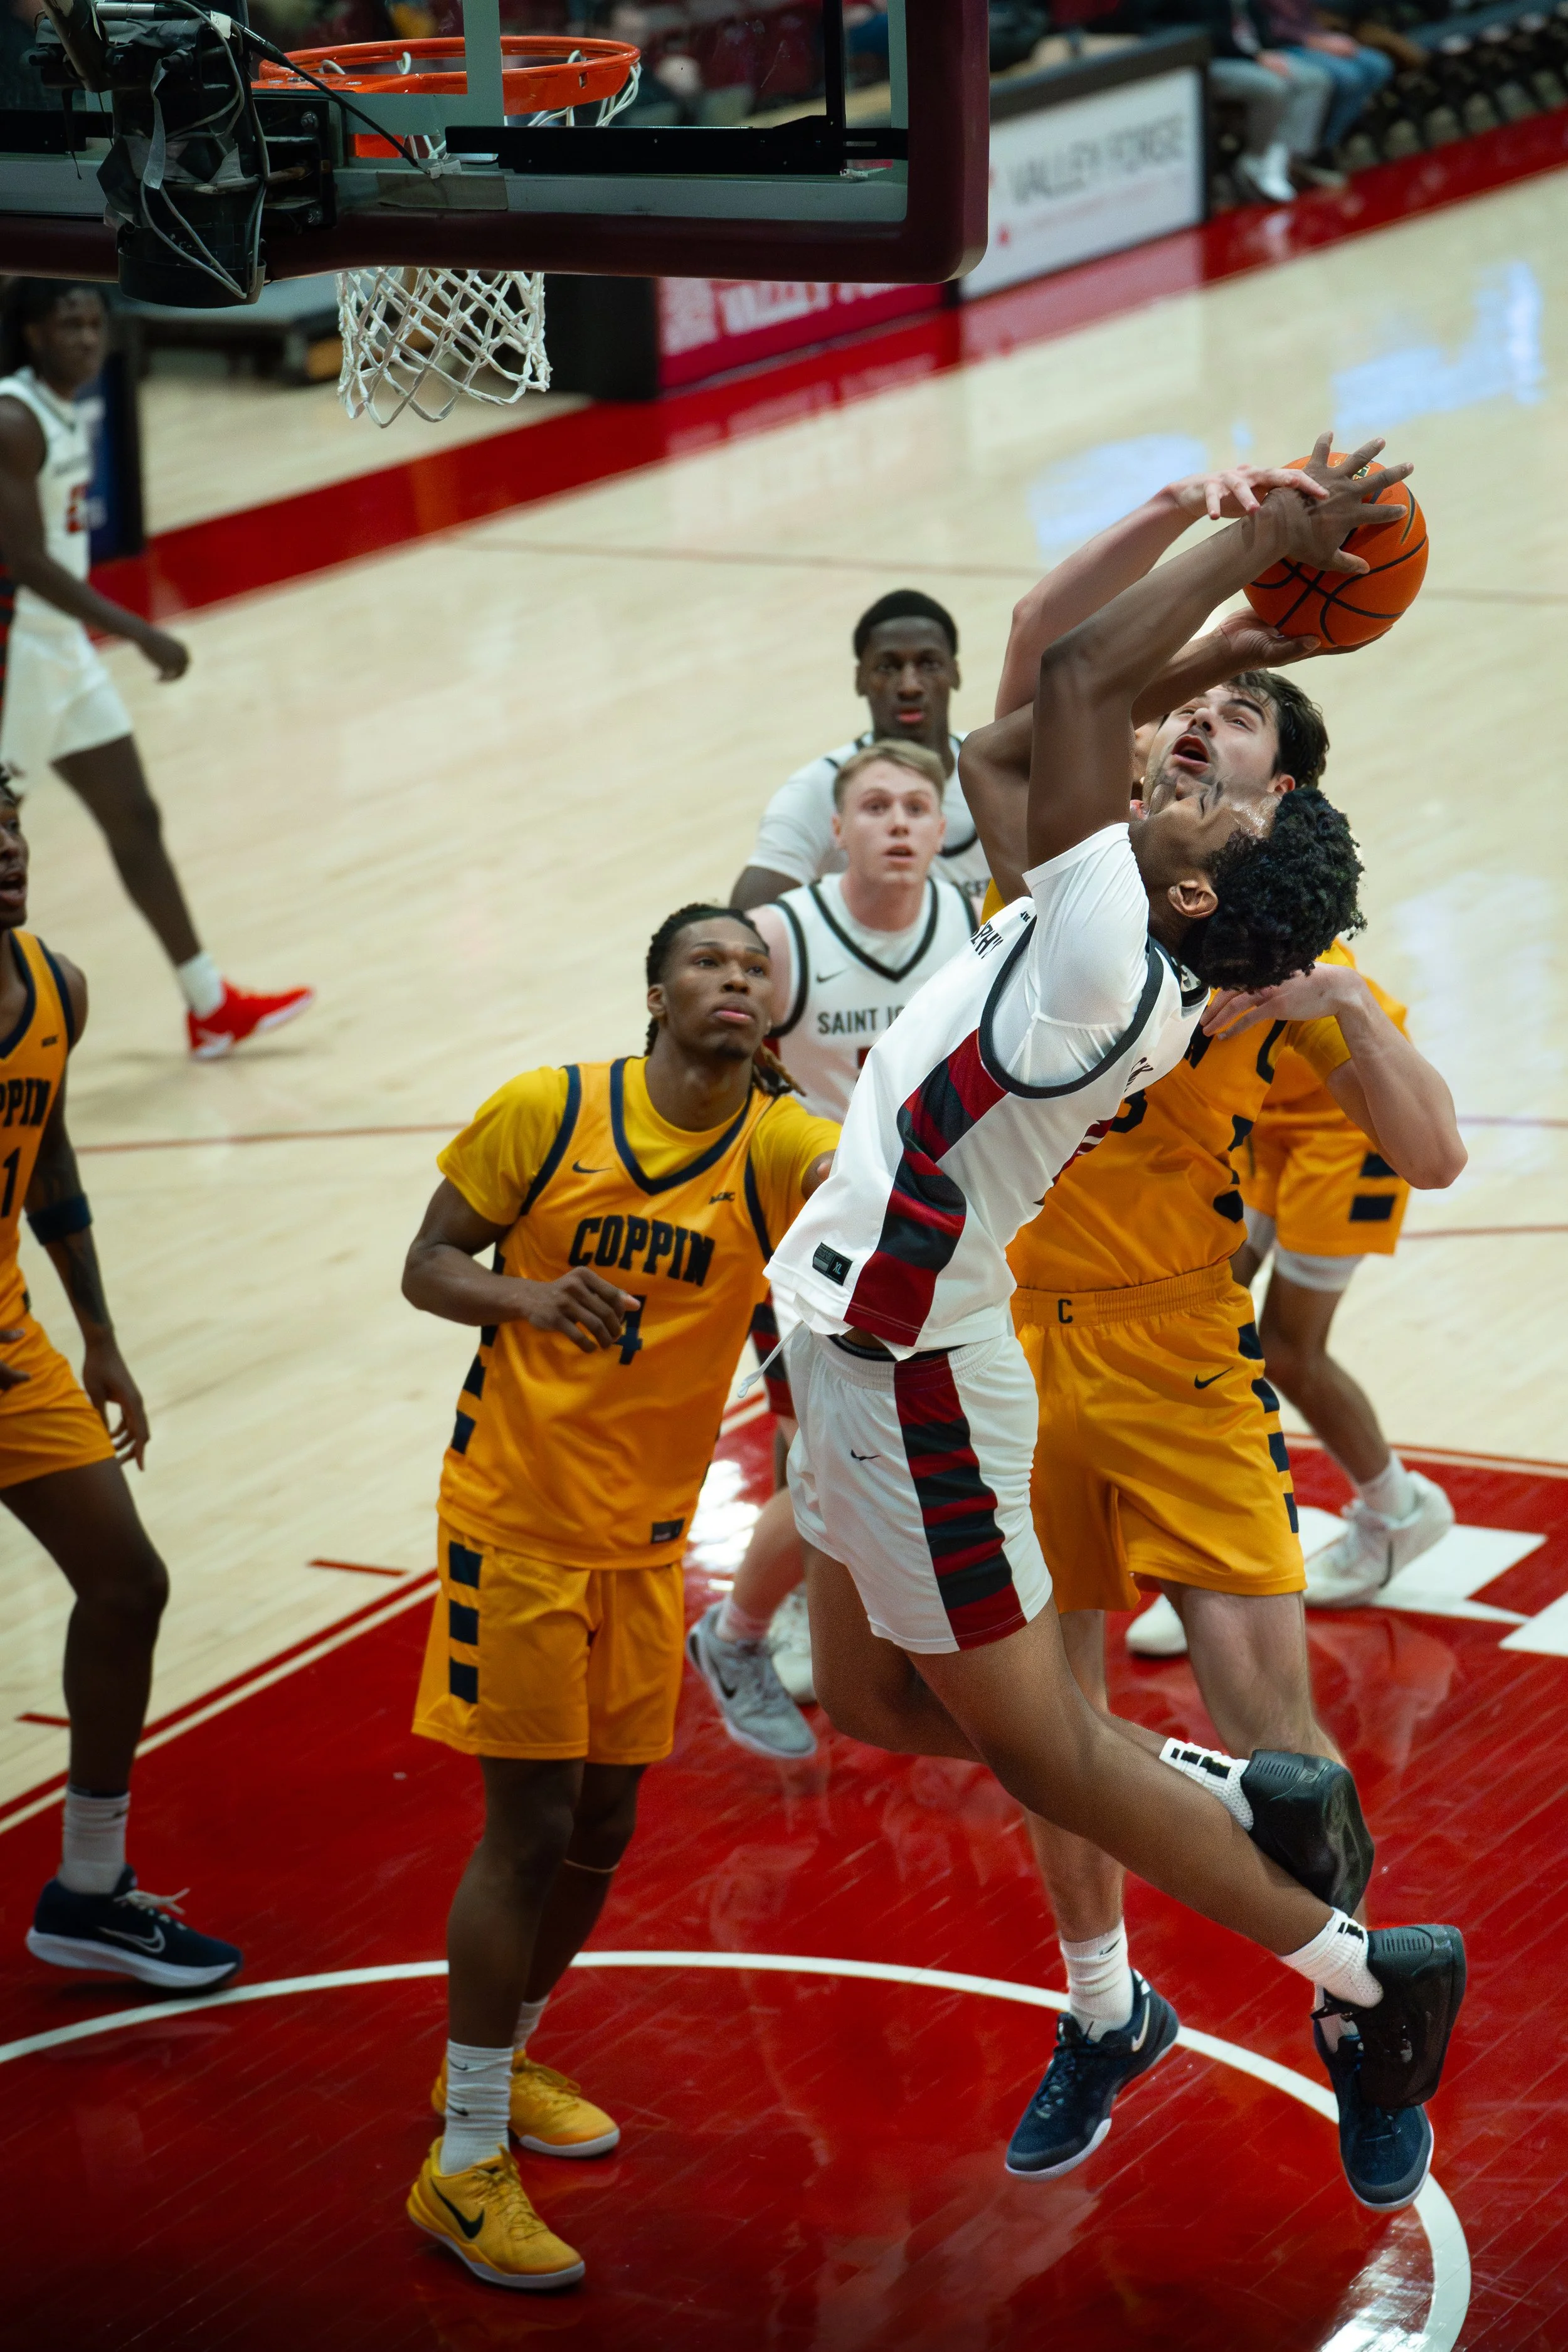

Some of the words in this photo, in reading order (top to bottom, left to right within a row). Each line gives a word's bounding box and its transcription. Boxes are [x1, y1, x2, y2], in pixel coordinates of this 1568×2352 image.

[817, 1007, 878, 1036] SAINT
[568, 1214, 715, 1287] COPPIN
[832, 1261, 842, 1275] XL
[1057, 1299, 1074, 1324] C
[607, 1294, 647, 1365] 4
